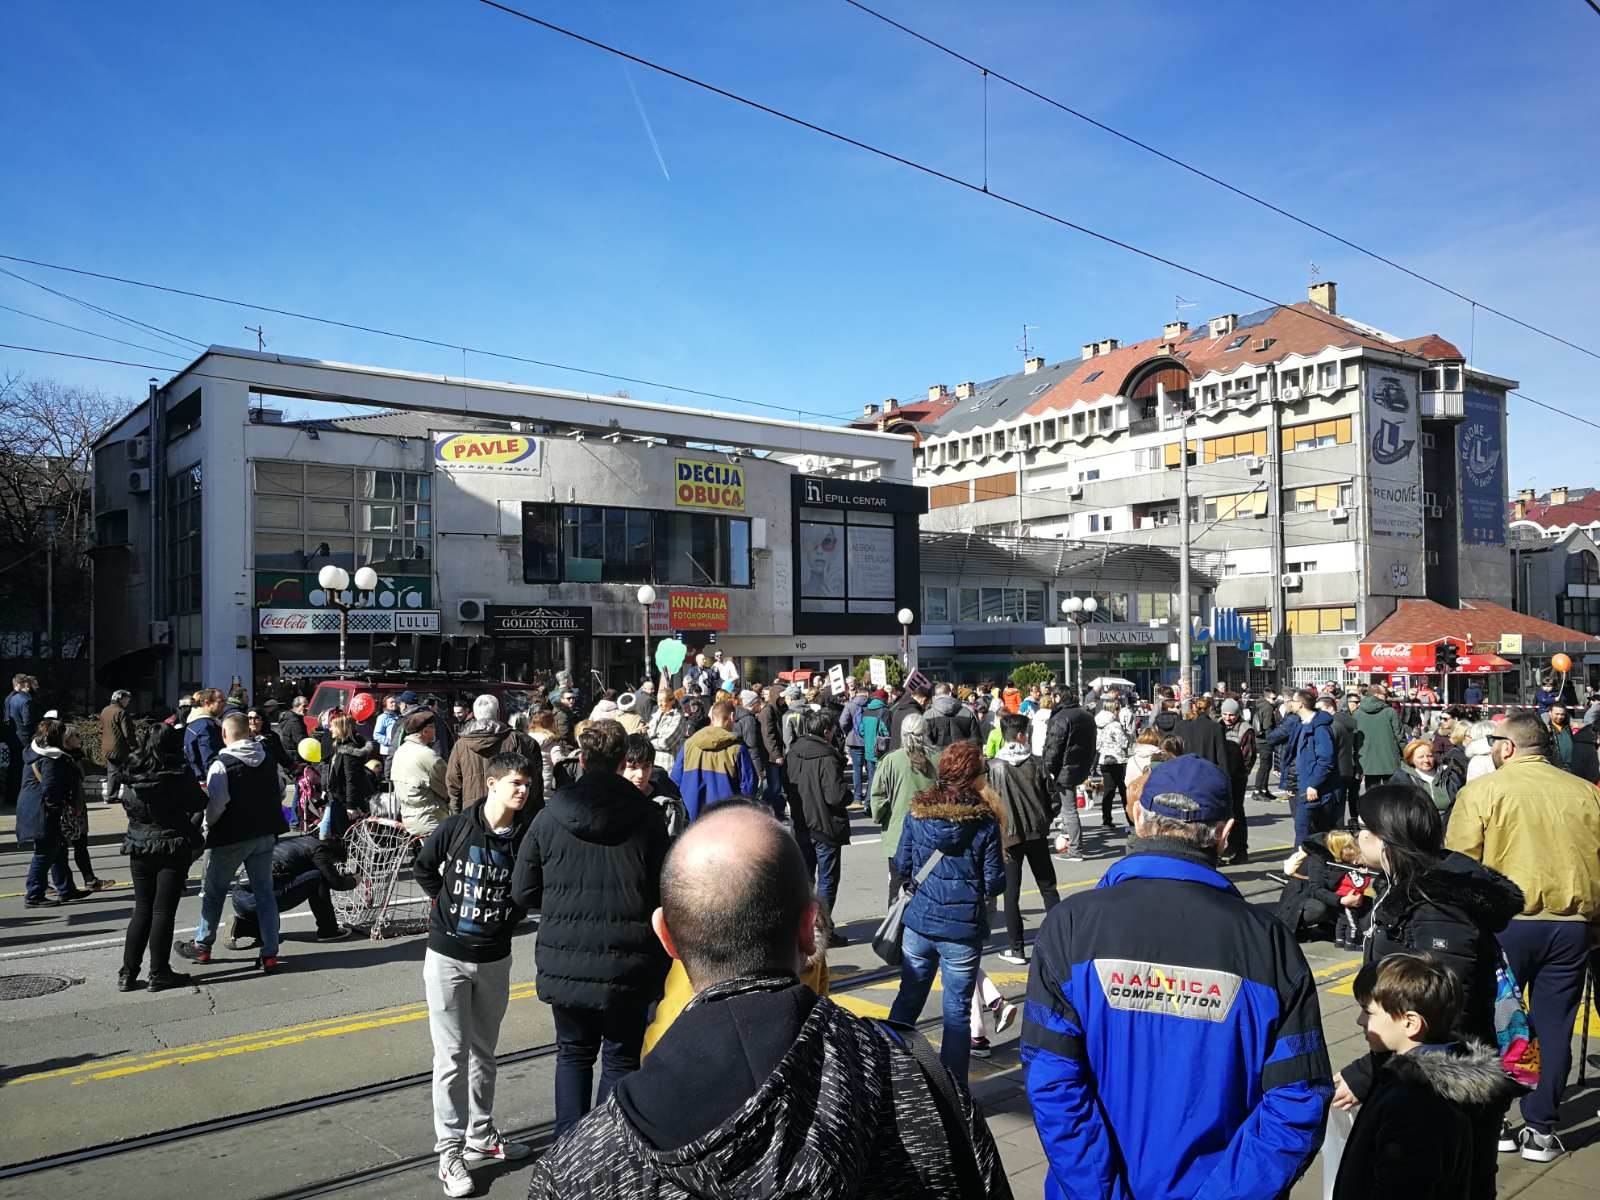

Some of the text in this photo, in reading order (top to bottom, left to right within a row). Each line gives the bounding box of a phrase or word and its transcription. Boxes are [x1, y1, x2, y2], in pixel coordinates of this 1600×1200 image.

[454, 439, 519, 459] PAVLE
[1462, 423, 1484, 460] RENOME
[678, 462, 742, 487] DEČIJA
[678, 484, 740, 507] OBUĆA
[825, 494, 851, 504] EPILL
[852, 496, 887, 506] CENTAR
[1373, 485, 1417, 502] RENOME
[671, 594, 727, 610] KNJIŽARA
[399, 616, 429, 627] LULU
[502, 619, 578, 629] GOLDEN GIRL
[1211, 607, 1250, 650] lilly
[795, 640, 807, 649] vip
[1099, 631, 1154, 643] BANCA INTESA
[449, 902, 513, 923] SUPPLY
[1111, 972, 1222, 997] NAUTICA
[1110, 987, 1222, 1009] COMPETITION
